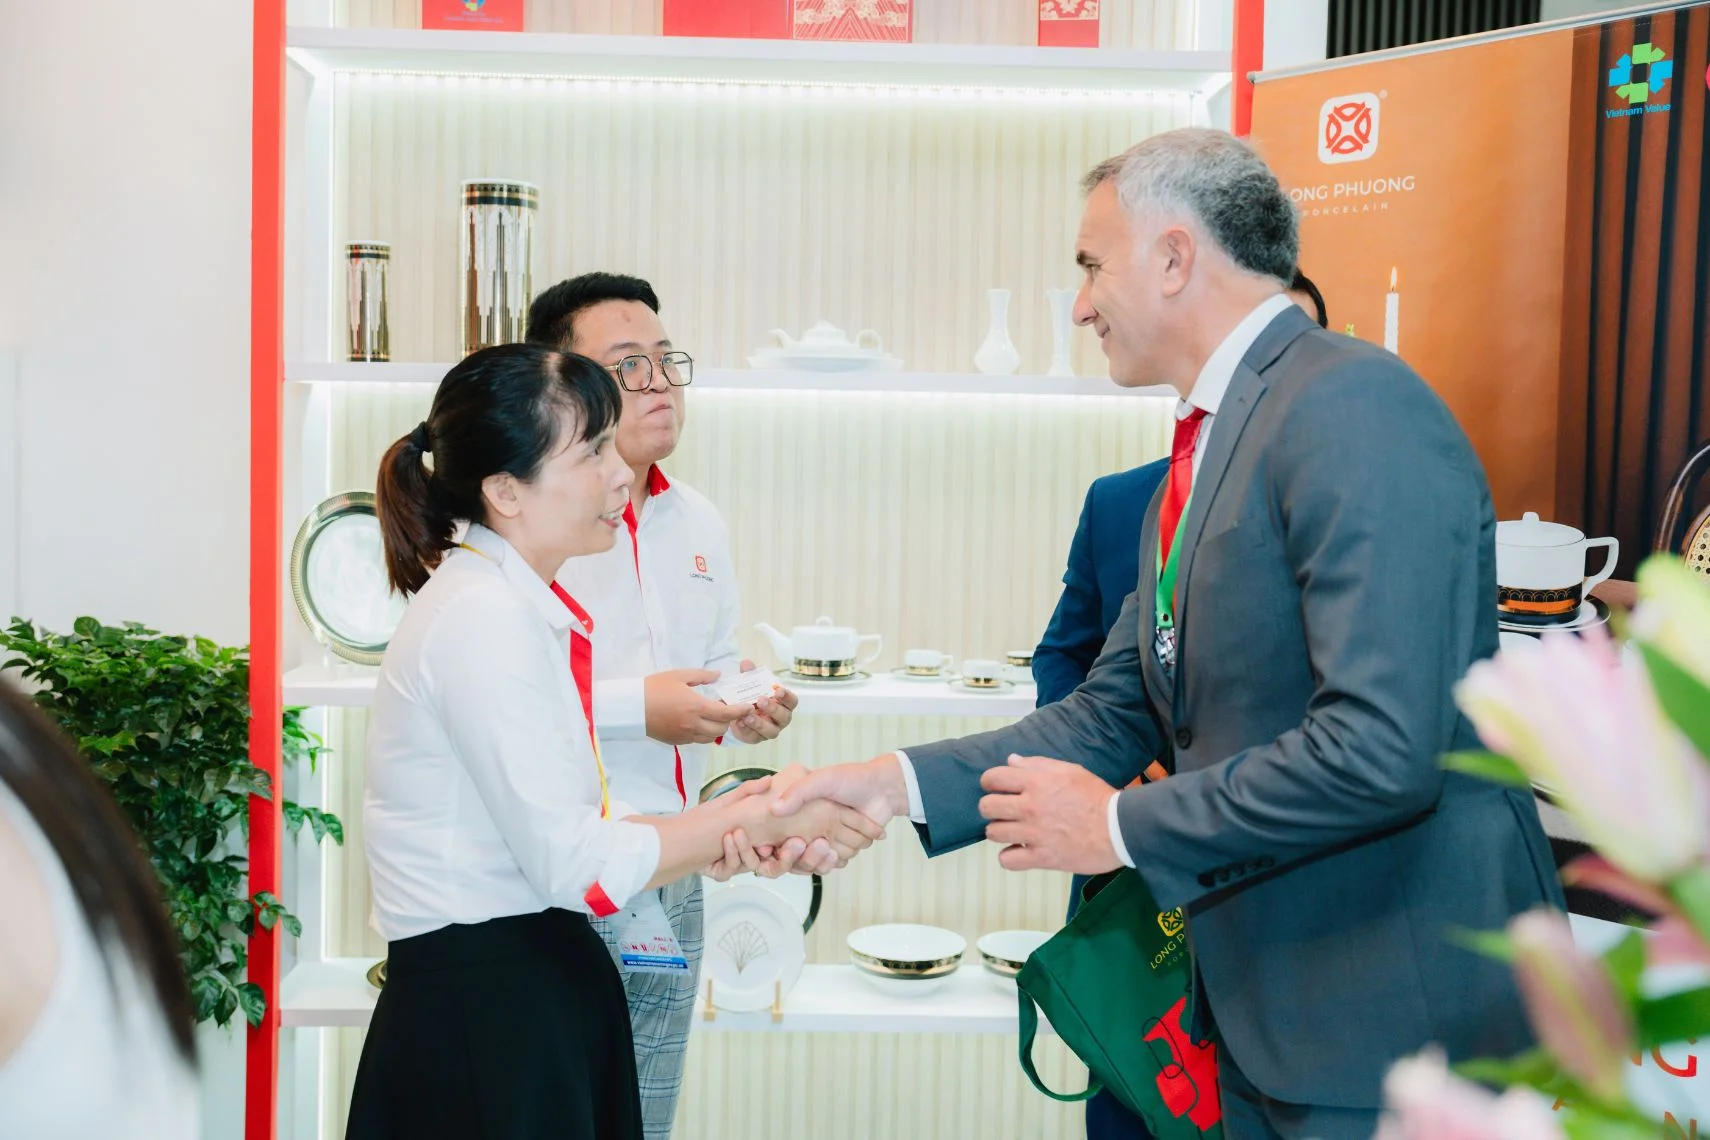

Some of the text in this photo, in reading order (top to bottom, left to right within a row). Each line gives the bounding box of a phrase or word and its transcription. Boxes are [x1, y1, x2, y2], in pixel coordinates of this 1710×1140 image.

[1606, 103, 1672, 118] Vietnam Value
[1288, 176, 1415, 202] ONG PHUONG
[1150, 940, 1177, 969] LONG
